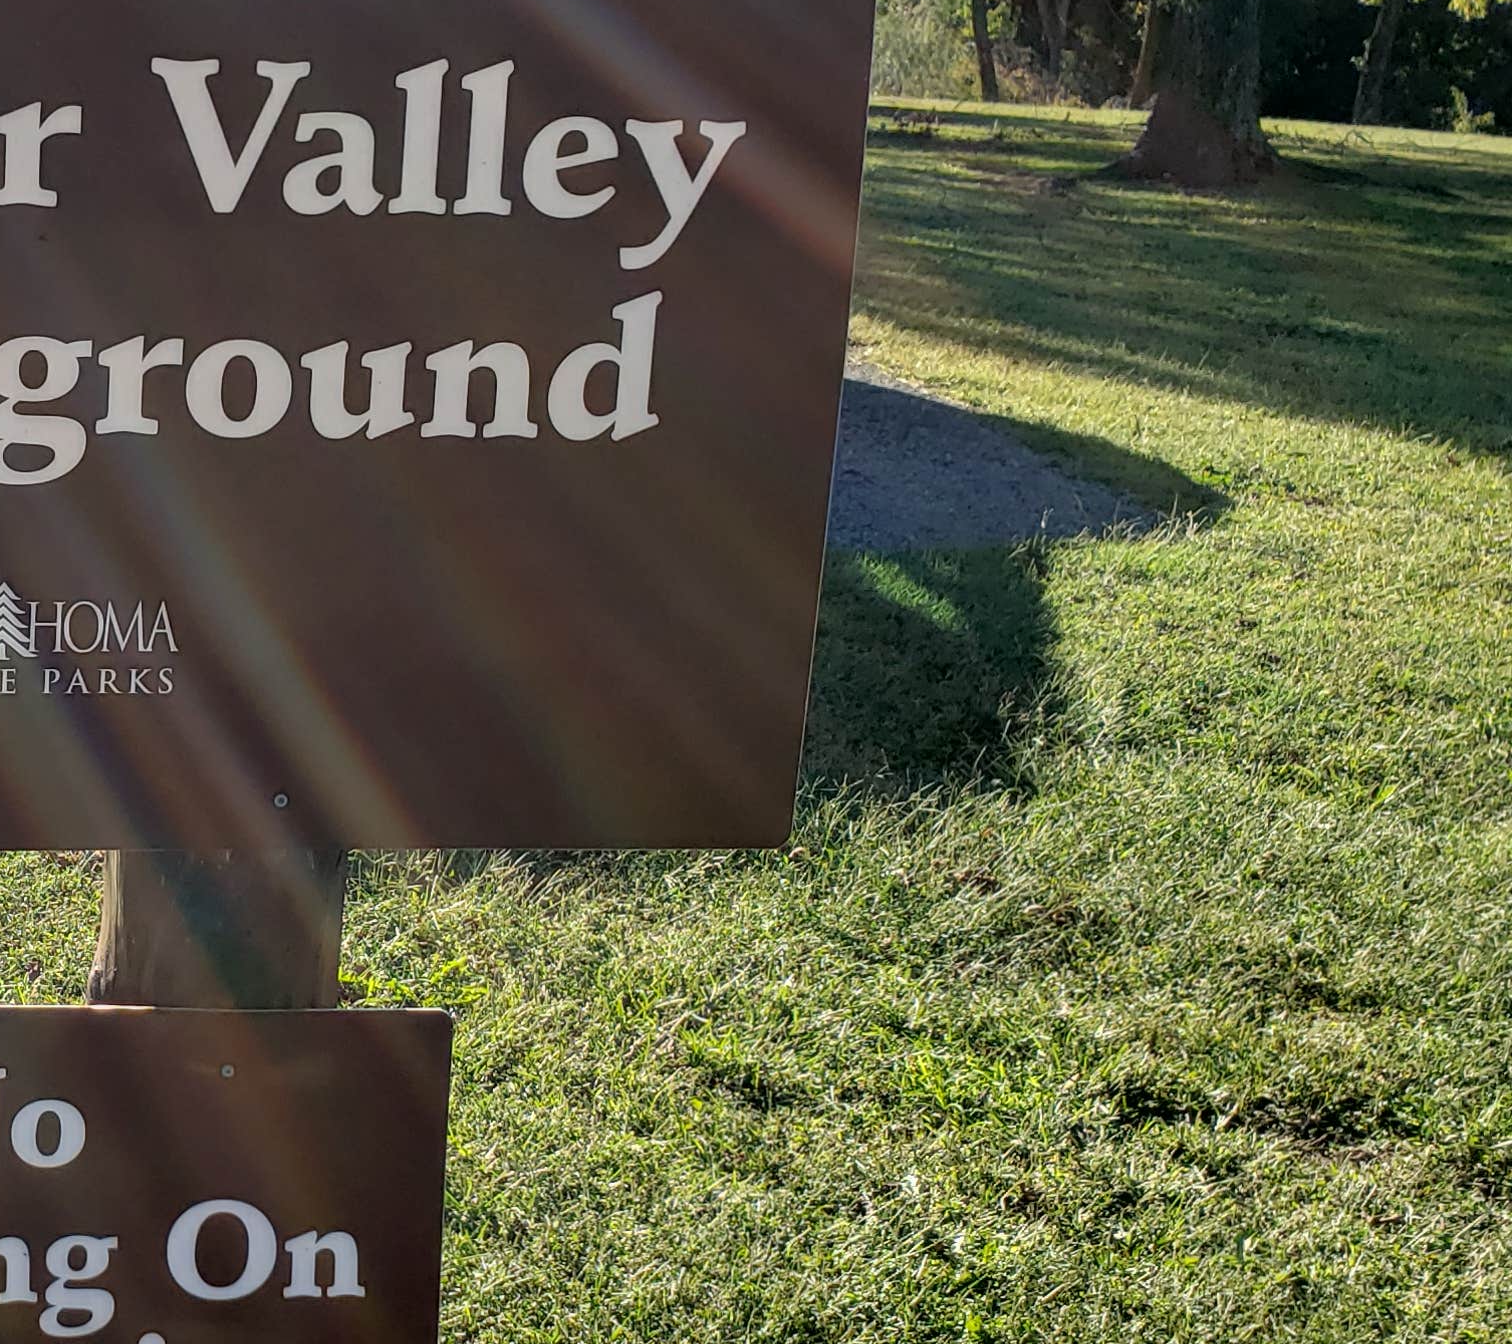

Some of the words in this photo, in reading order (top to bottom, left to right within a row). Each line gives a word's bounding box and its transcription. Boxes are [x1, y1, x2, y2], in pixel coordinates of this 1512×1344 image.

[151, 57, 747, 270] Valley
[41, 667, 174, 695] PARKS
[166, 1199, 366, 1301] On
